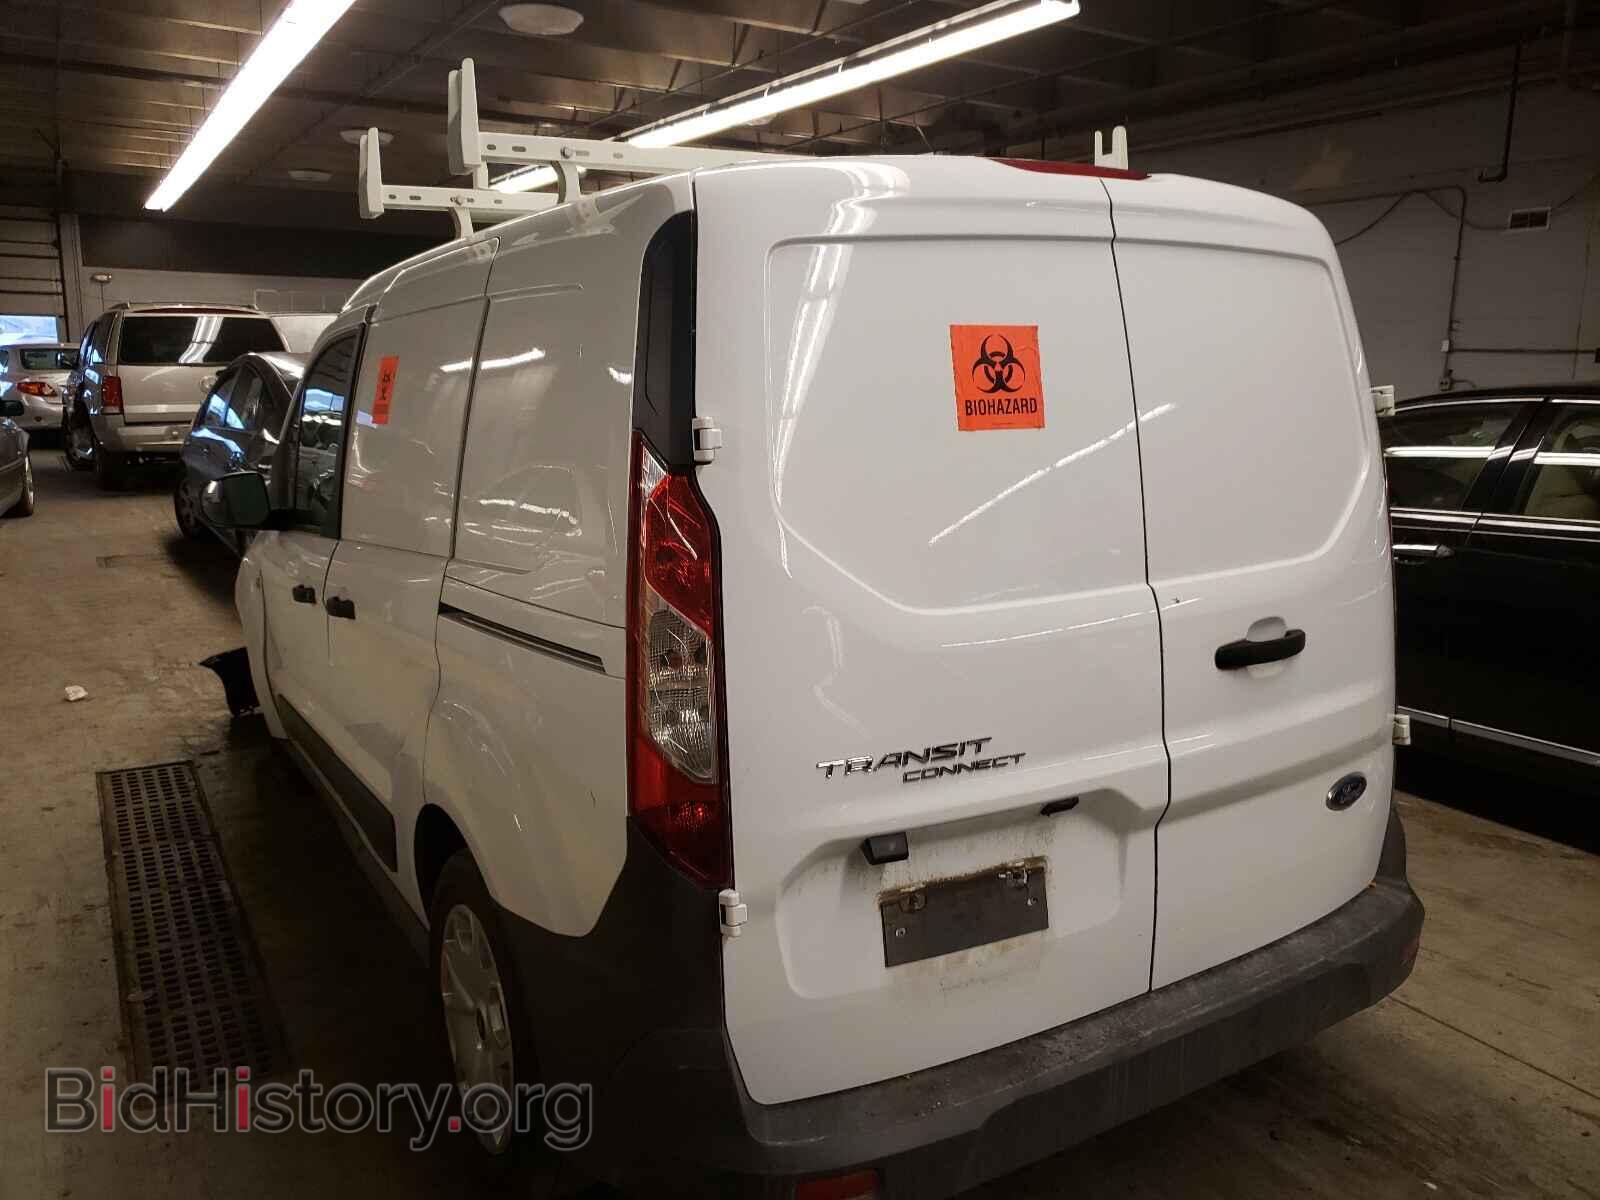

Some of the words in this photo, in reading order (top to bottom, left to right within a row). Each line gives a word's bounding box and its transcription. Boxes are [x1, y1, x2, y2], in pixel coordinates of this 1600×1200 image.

[965, 398, 1038, 416] BIOHAZARD
[816, 737, 992, 779] TRANSIT
[903, 753, 1026, 783] CONNECT
